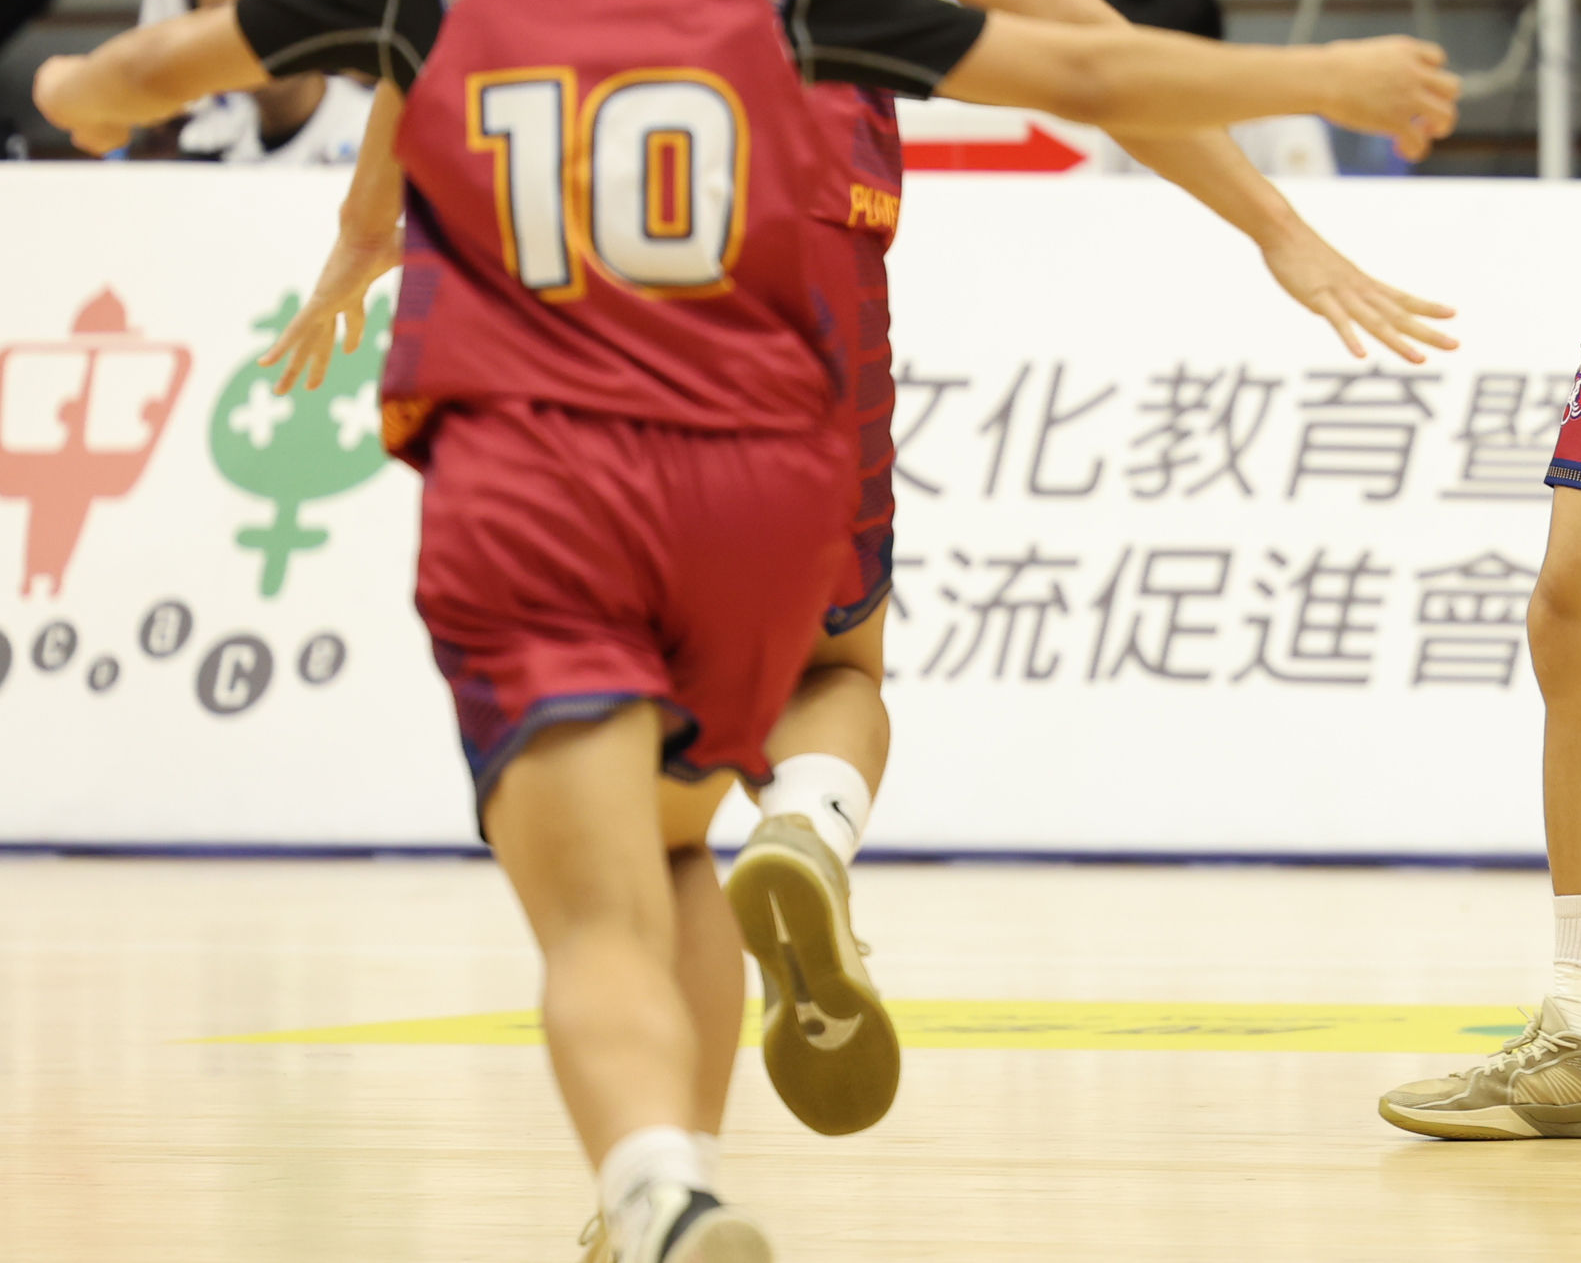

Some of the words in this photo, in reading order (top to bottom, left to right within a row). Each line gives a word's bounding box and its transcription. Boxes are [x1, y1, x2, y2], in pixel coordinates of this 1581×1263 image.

[466, 65, 750, 302] 10
[886, 543, 1542, 692] 流促進會
